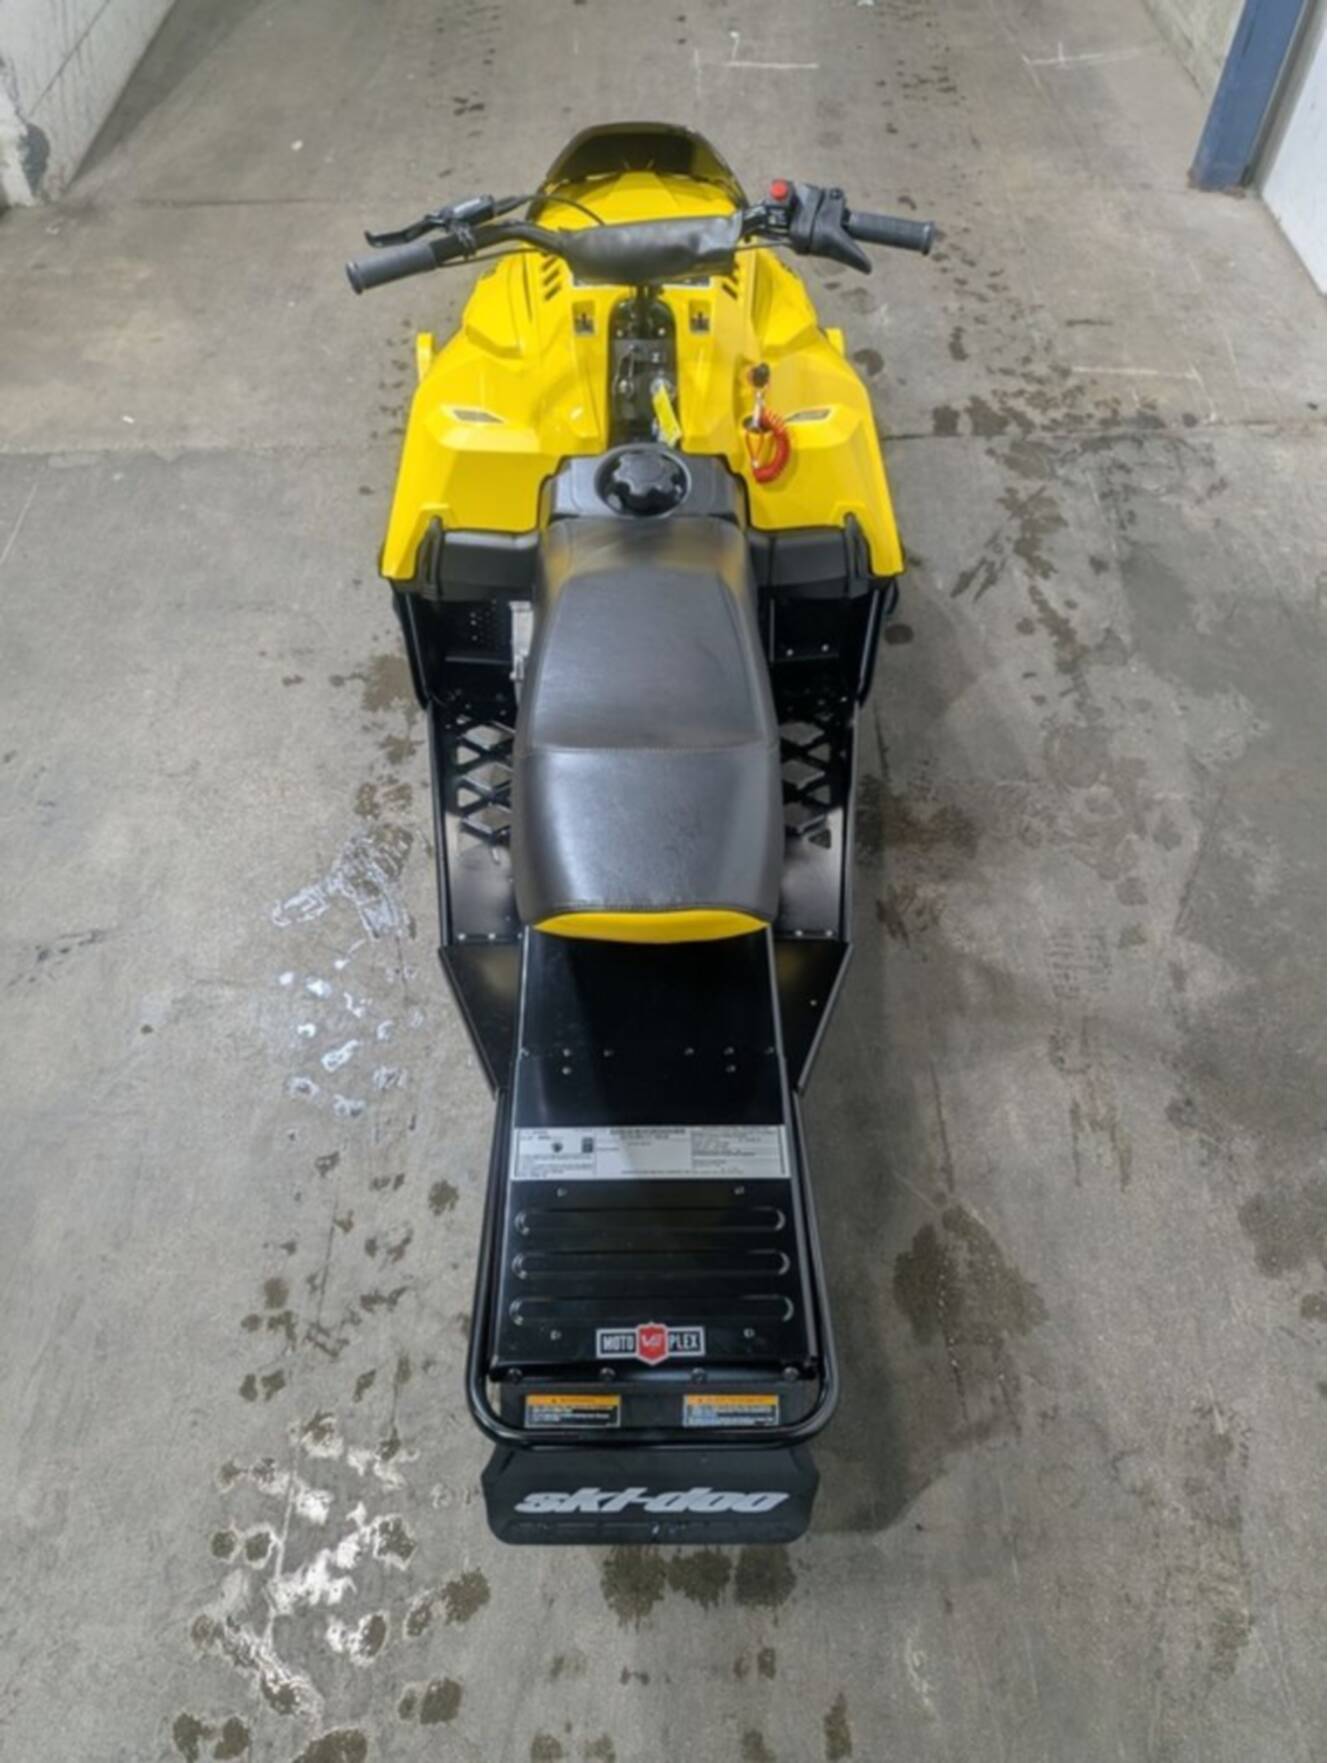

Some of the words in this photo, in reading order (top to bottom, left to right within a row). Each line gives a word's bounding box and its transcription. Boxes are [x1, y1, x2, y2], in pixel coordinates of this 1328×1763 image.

[603, 1335, 634, 1350] MOTO
[669, 1333, 698, 1349] PLEX
[514, 1487, 789, 1513] ski-doo
